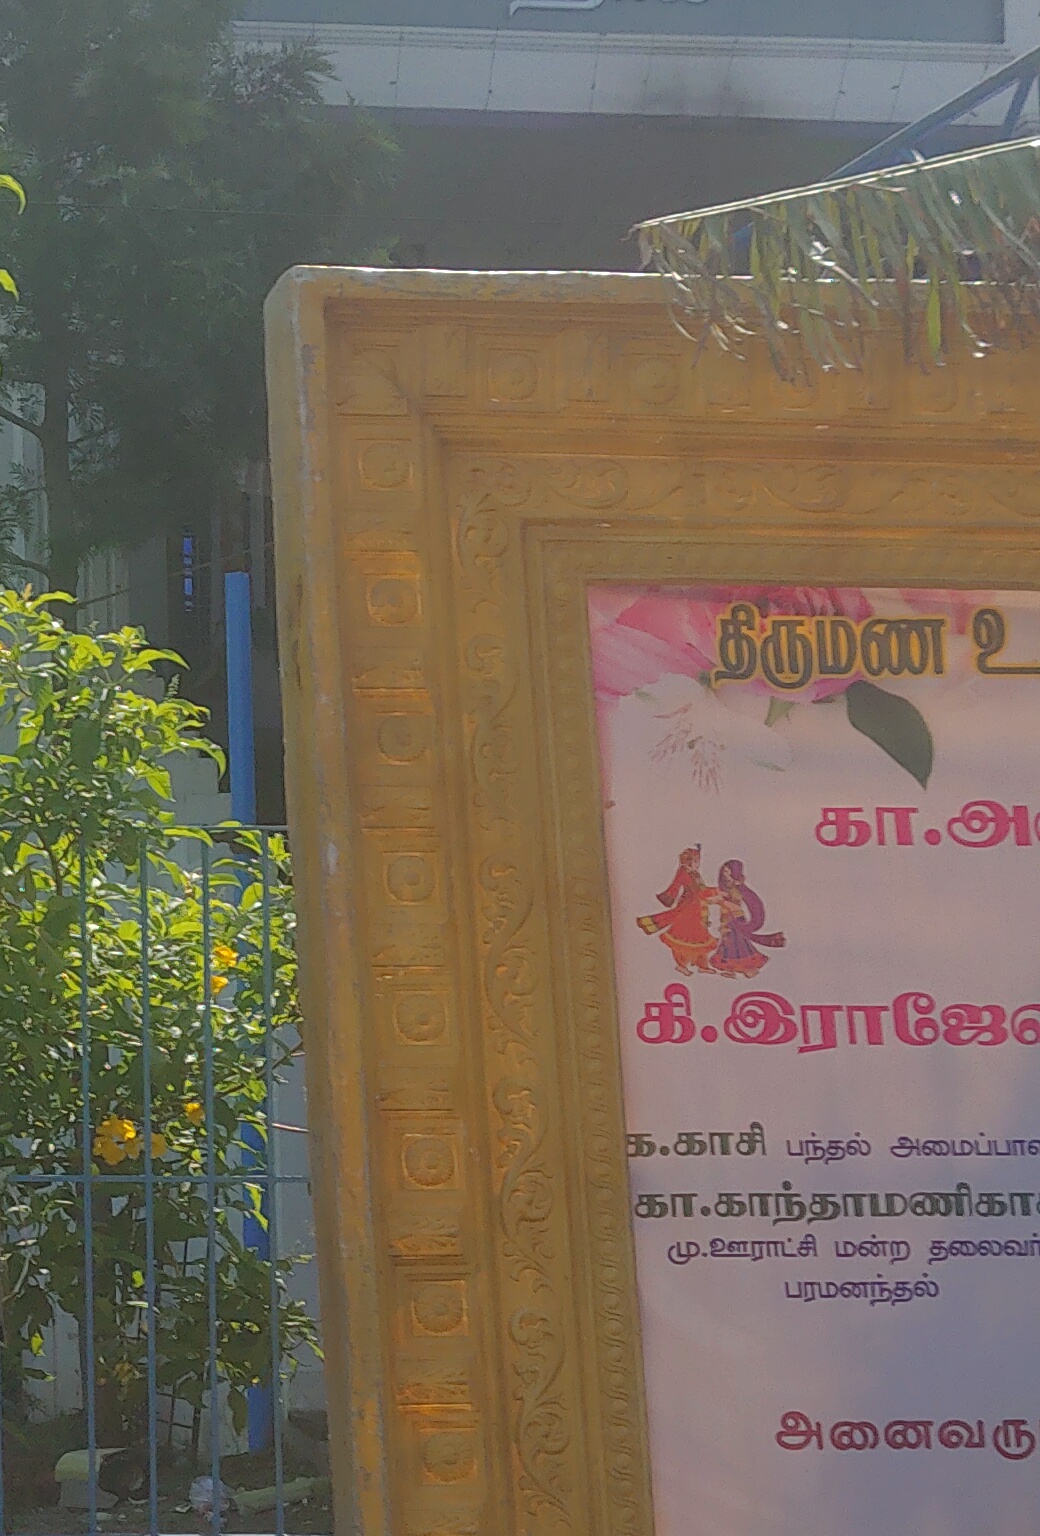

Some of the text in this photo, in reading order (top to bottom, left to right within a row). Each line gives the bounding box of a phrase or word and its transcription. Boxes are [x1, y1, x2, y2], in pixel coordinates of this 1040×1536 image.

[712, 602, 948, 690] திருமண
[815, 800, 1040, 848] கா.அ
[786, 1131, 871, 1165] பந்தல்
[635, 1180, 1040, 1226] கா.காந்தாமணிகா
[667, 1233, 818, 1265] மு.ஊராட்சி
[834, 1233, 911, 1265] மன்ற
[774, 1410, 1040, 1460] அனைவரு
